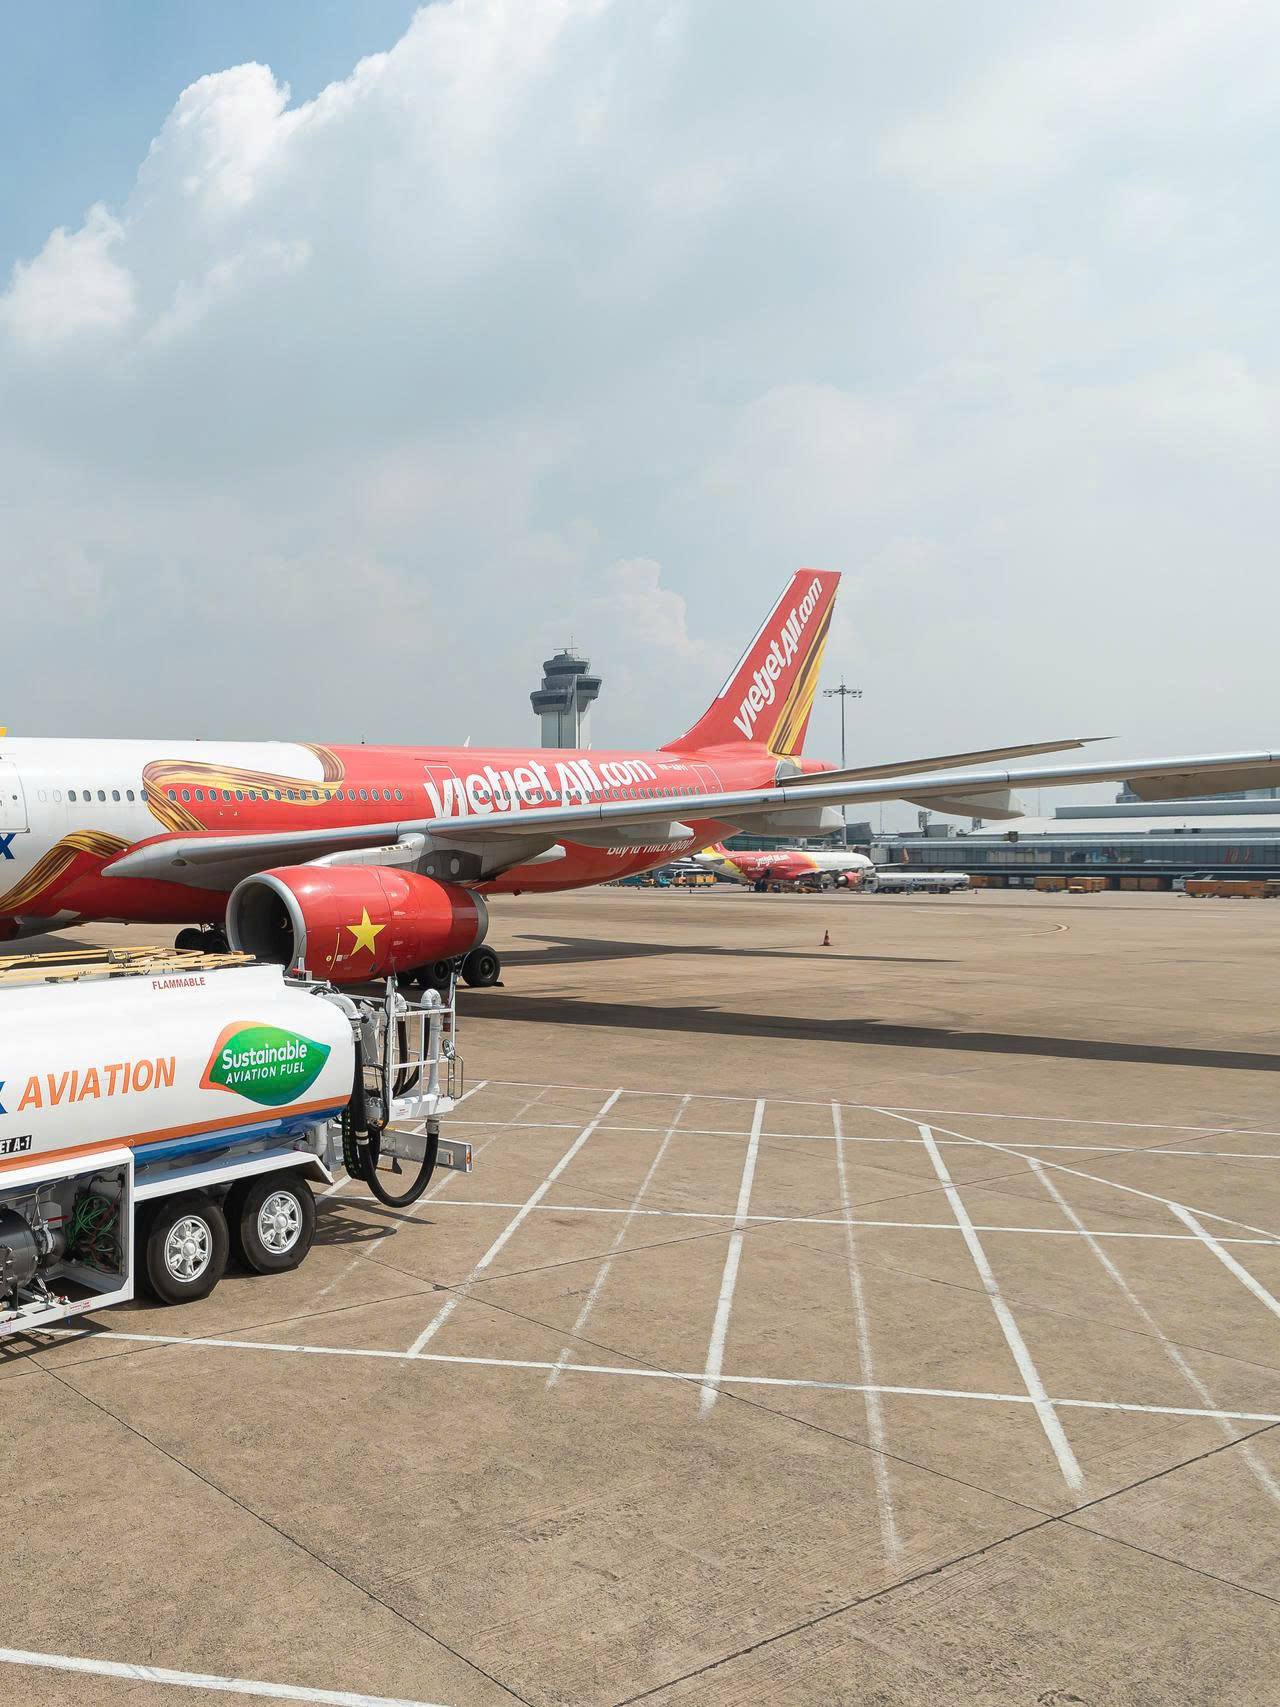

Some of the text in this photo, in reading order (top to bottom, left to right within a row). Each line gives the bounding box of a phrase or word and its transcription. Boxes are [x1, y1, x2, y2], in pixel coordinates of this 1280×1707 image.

[152, 977, 206, 990] FLAMMABLE
[222, 1040, 307, 1070] Sustainable
[17, 1056, 177, 1112] AVIATION
[225, 1062, 305, 1084] AVIATION FUEL
[13, 1136, 30, 1151] A-1
